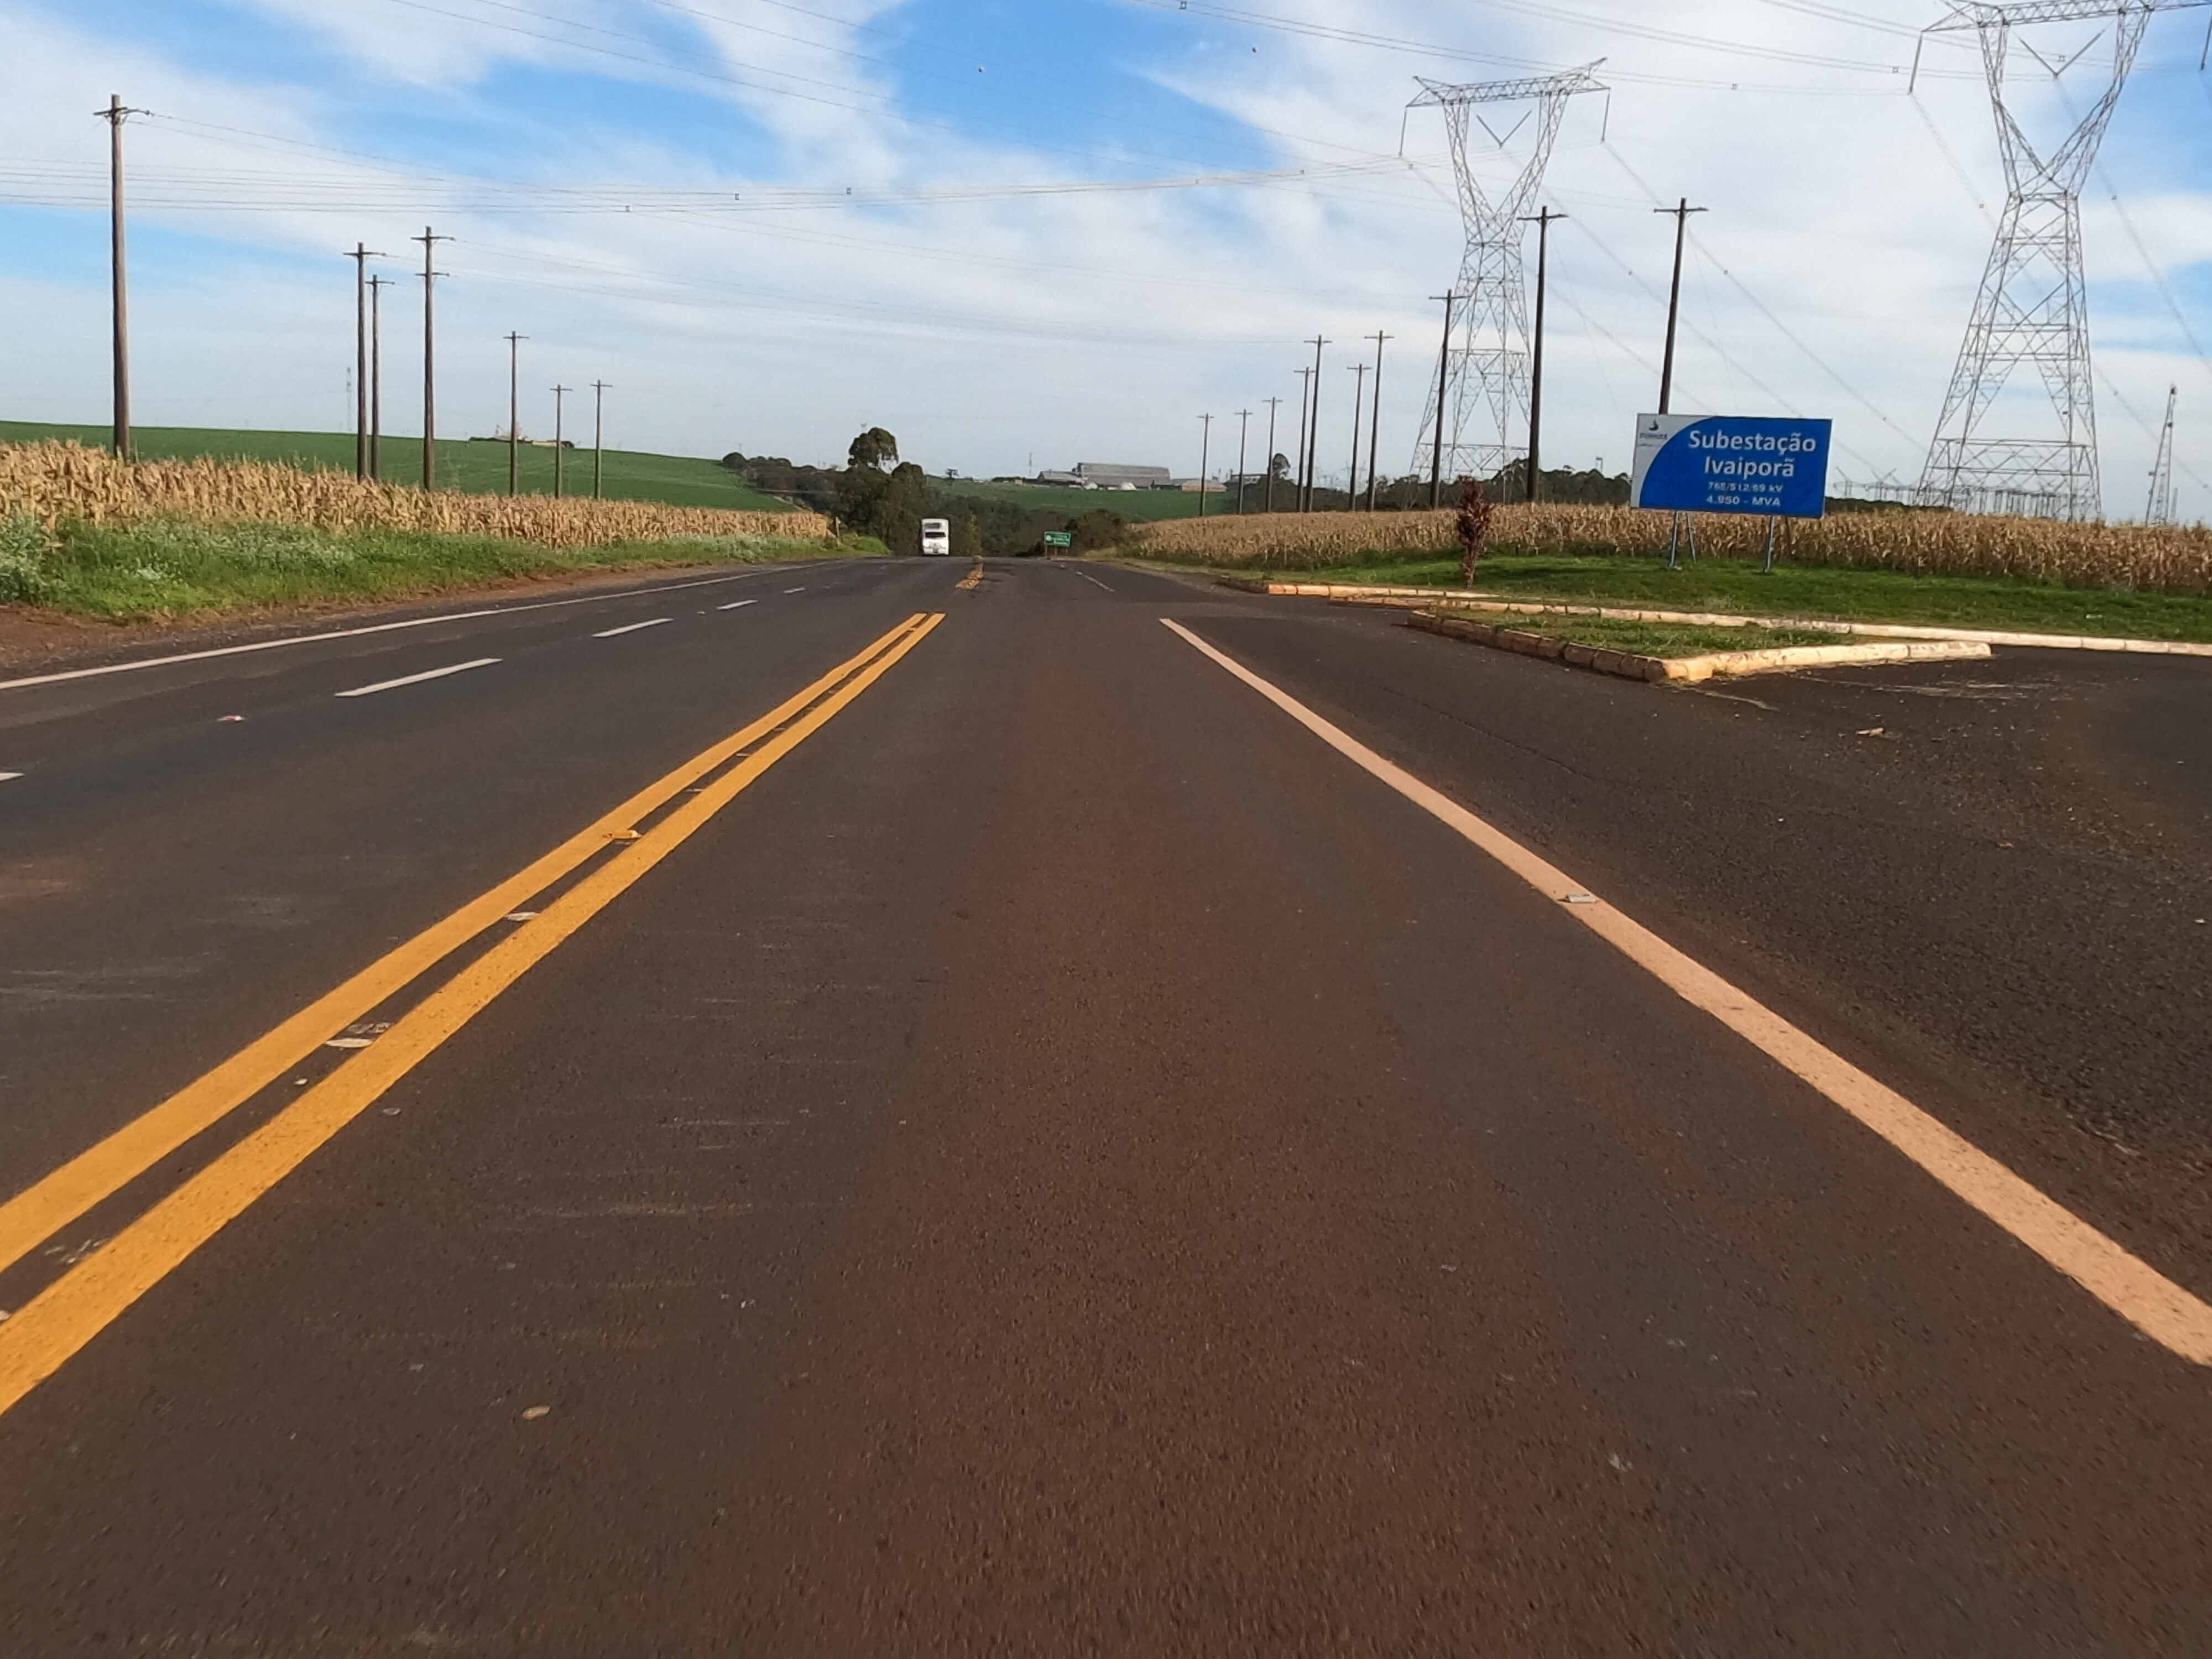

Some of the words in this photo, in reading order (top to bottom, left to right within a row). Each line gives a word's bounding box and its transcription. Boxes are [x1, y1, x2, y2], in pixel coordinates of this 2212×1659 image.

[1688, 430, 1816, 456] Subestação
[1704, 456, 1795, 480] Ivaiporã
[1751, 496, 1781, 506] MVA
